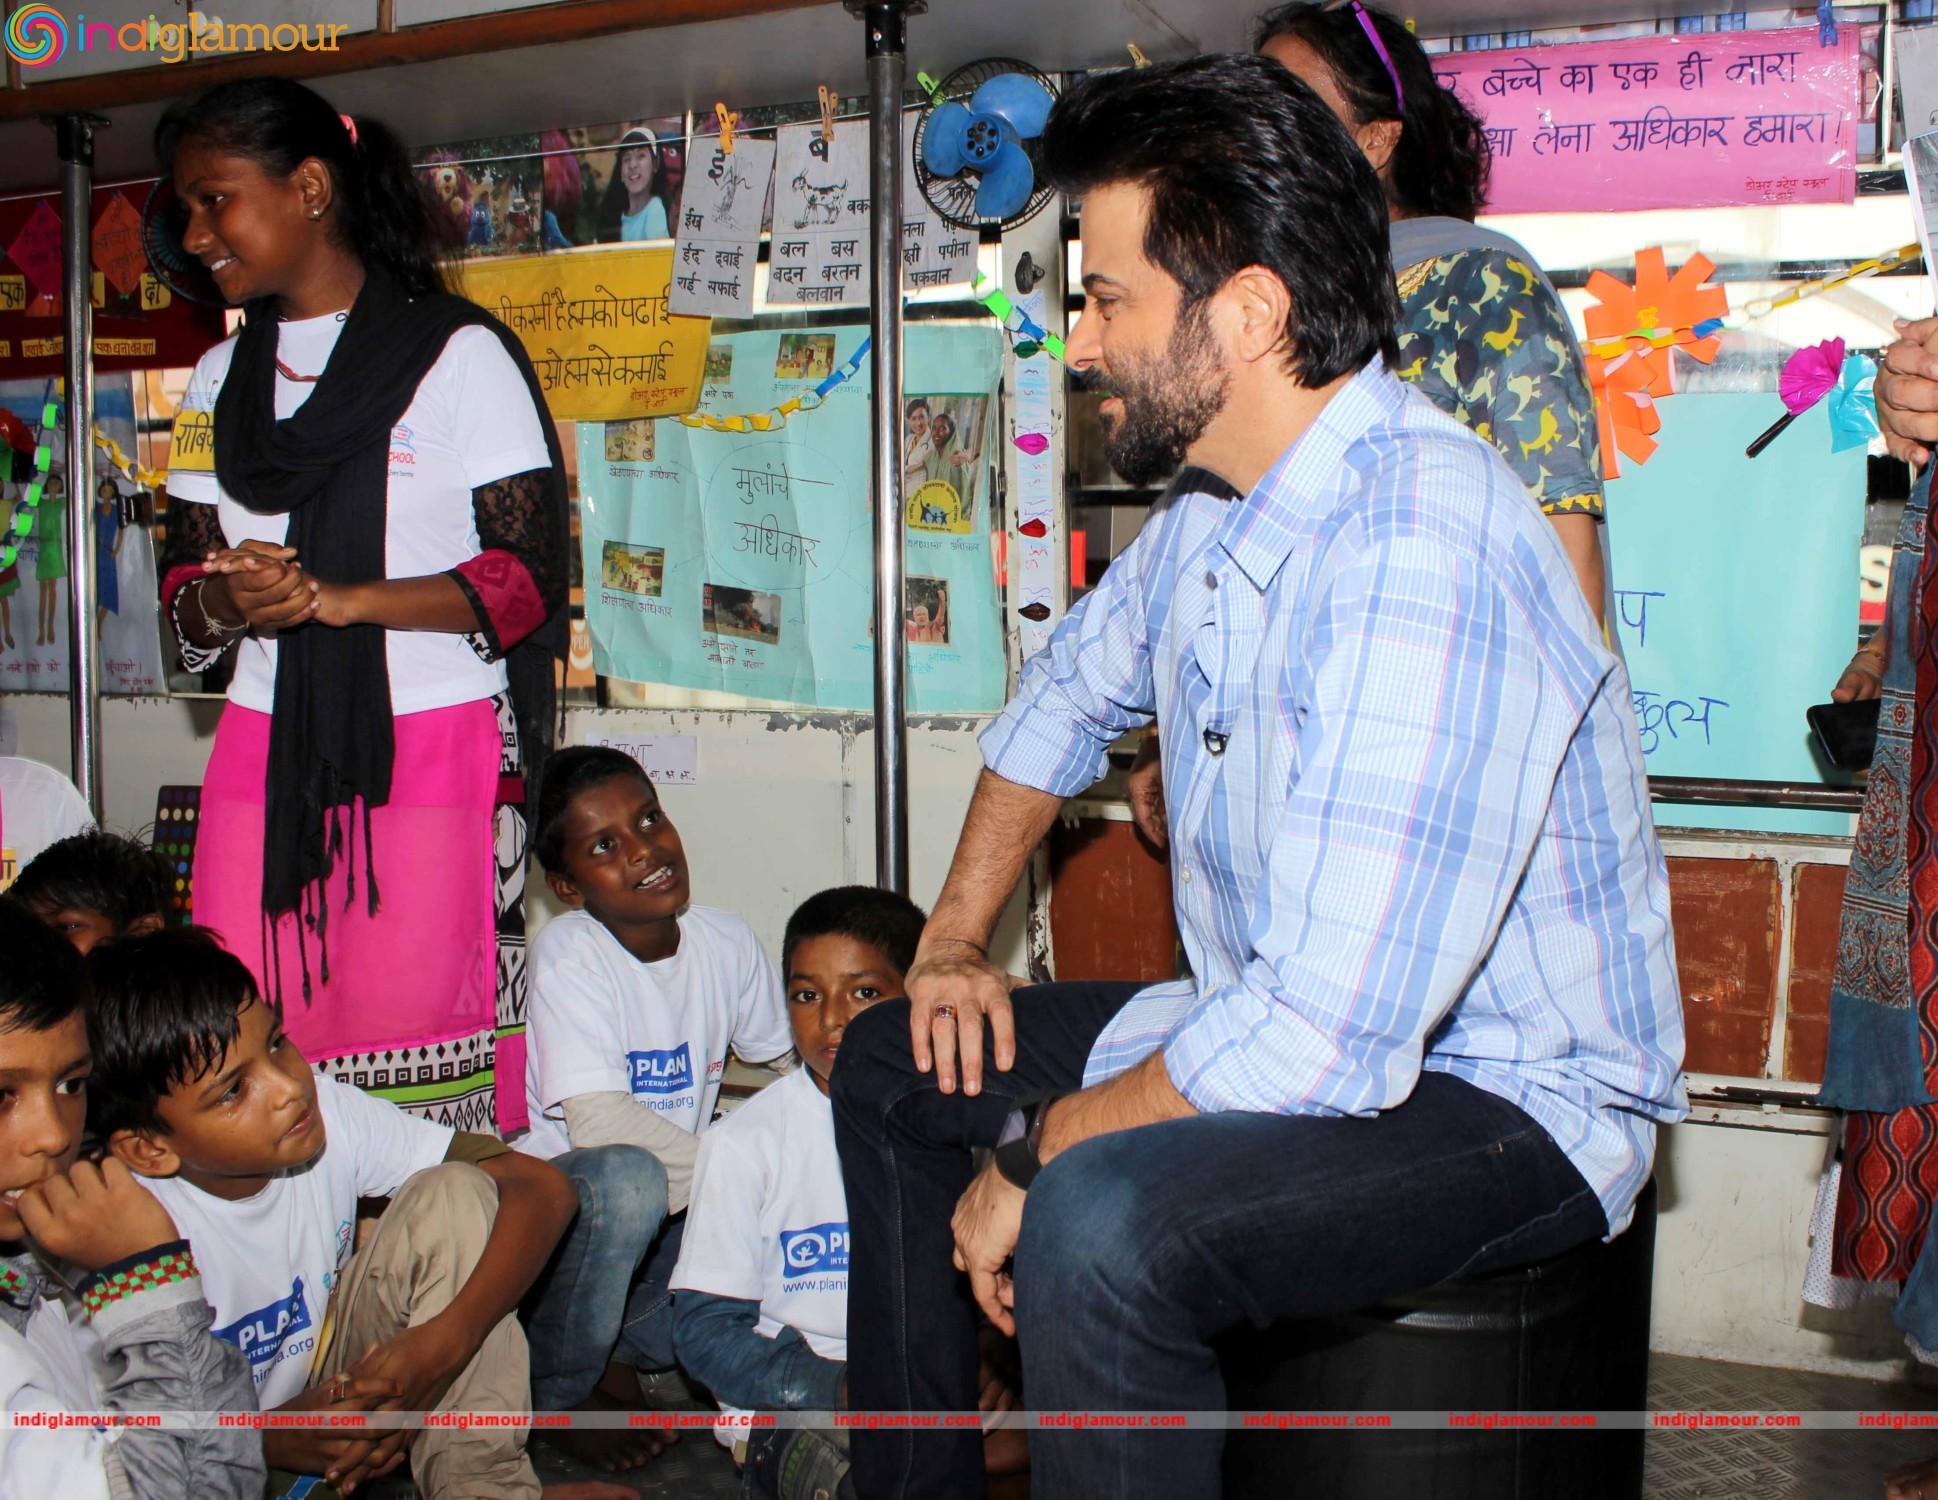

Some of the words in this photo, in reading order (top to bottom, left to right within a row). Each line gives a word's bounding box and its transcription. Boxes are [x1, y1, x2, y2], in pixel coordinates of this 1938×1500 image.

[1483, 57, 1551, 96] बच्चे
[1560, 64, 1598, 94] का
[1608, 61, 1659, 90] एक
[1678, 51, 1712, 90] ही
[1726, 52, 1802, 86] नारा
[1533, 112, 1595, 155] लेना
[1609, 106, 1735, 151] अधिकार
[847, 199, 871, 215] बक
[684, 208, 704, 232] ईख
[903, 222, 926, 237] तला
[682, 243, 704, 265] ईद
[715, 246, 744, 269] दवाई
[780, 242, 809, 258] बल
[831, 240, 858, 257] बस
[903, 243, 922, 265] क्षी
[938, 239, 970, 260] पपीता
[773, 267, 807, 284] बदन
[822, 264, 862, 282] बरतन
[909, 268, 952, 286] पकवान
[678, 272, 701, 295] राई
[707, 277, 741, 300] सफाई
[797, 286, 845, 302] बलवान
[176, 411, 214, 457] राबिय
[389, 452, 416, 464] CHOOL
[733, 513, 821, 568] अधिकार
[1614, 590, 1666, 648] प
[636, 1054, 687, 1077] PLAN
[831, 1257, 849, 1265] INTE
[783, 1277, 847, 1293] www.plani
